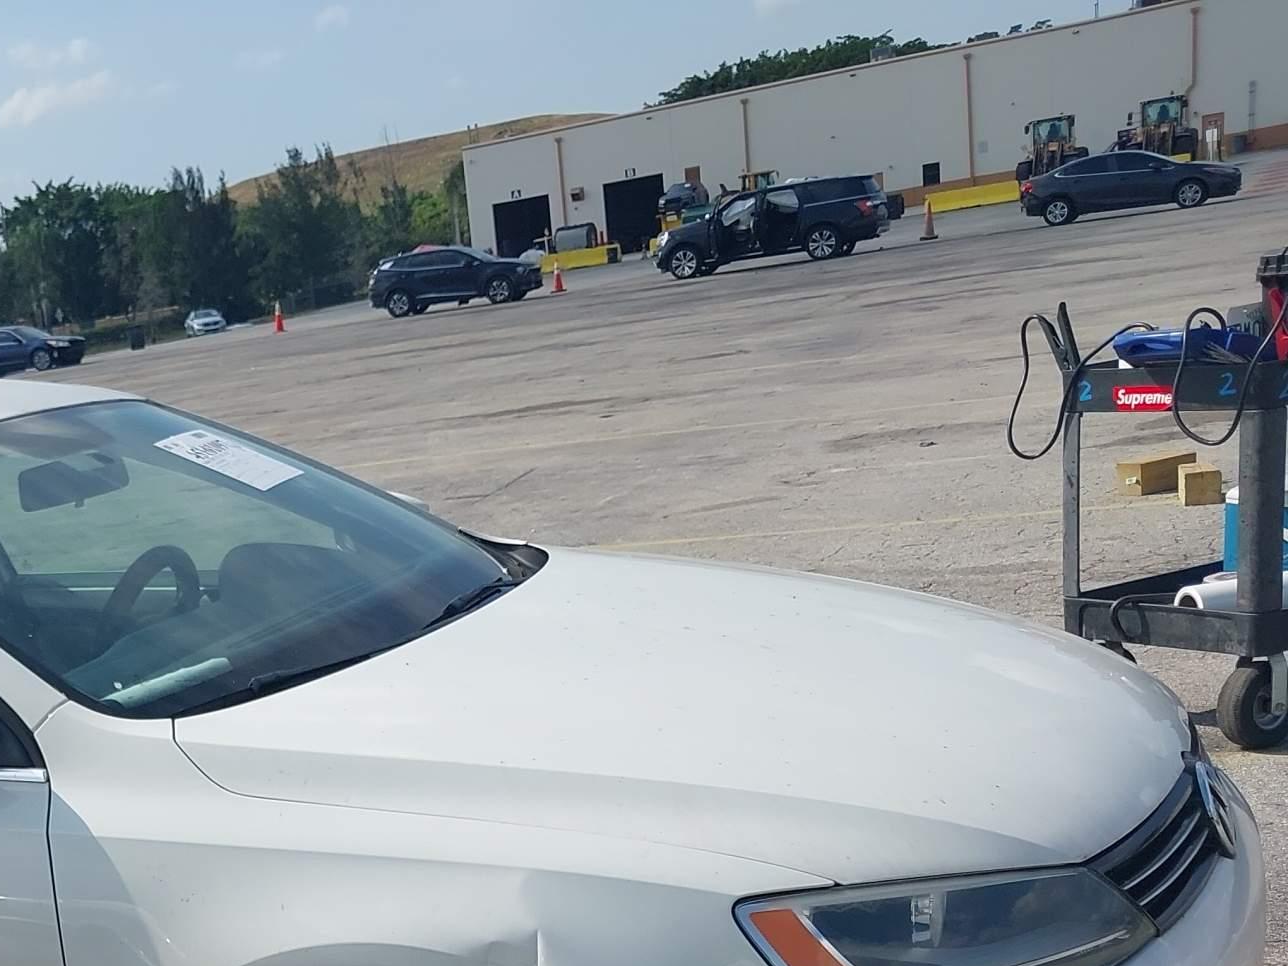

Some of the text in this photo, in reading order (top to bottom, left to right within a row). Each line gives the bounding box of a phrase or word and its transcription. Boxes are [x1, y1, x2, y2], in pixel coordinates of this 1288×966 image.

[1078, 381, 1092, 401] 2
[1219, 373, 1237, 396] 2
[1117, 389, 1172, 405] Supreme
